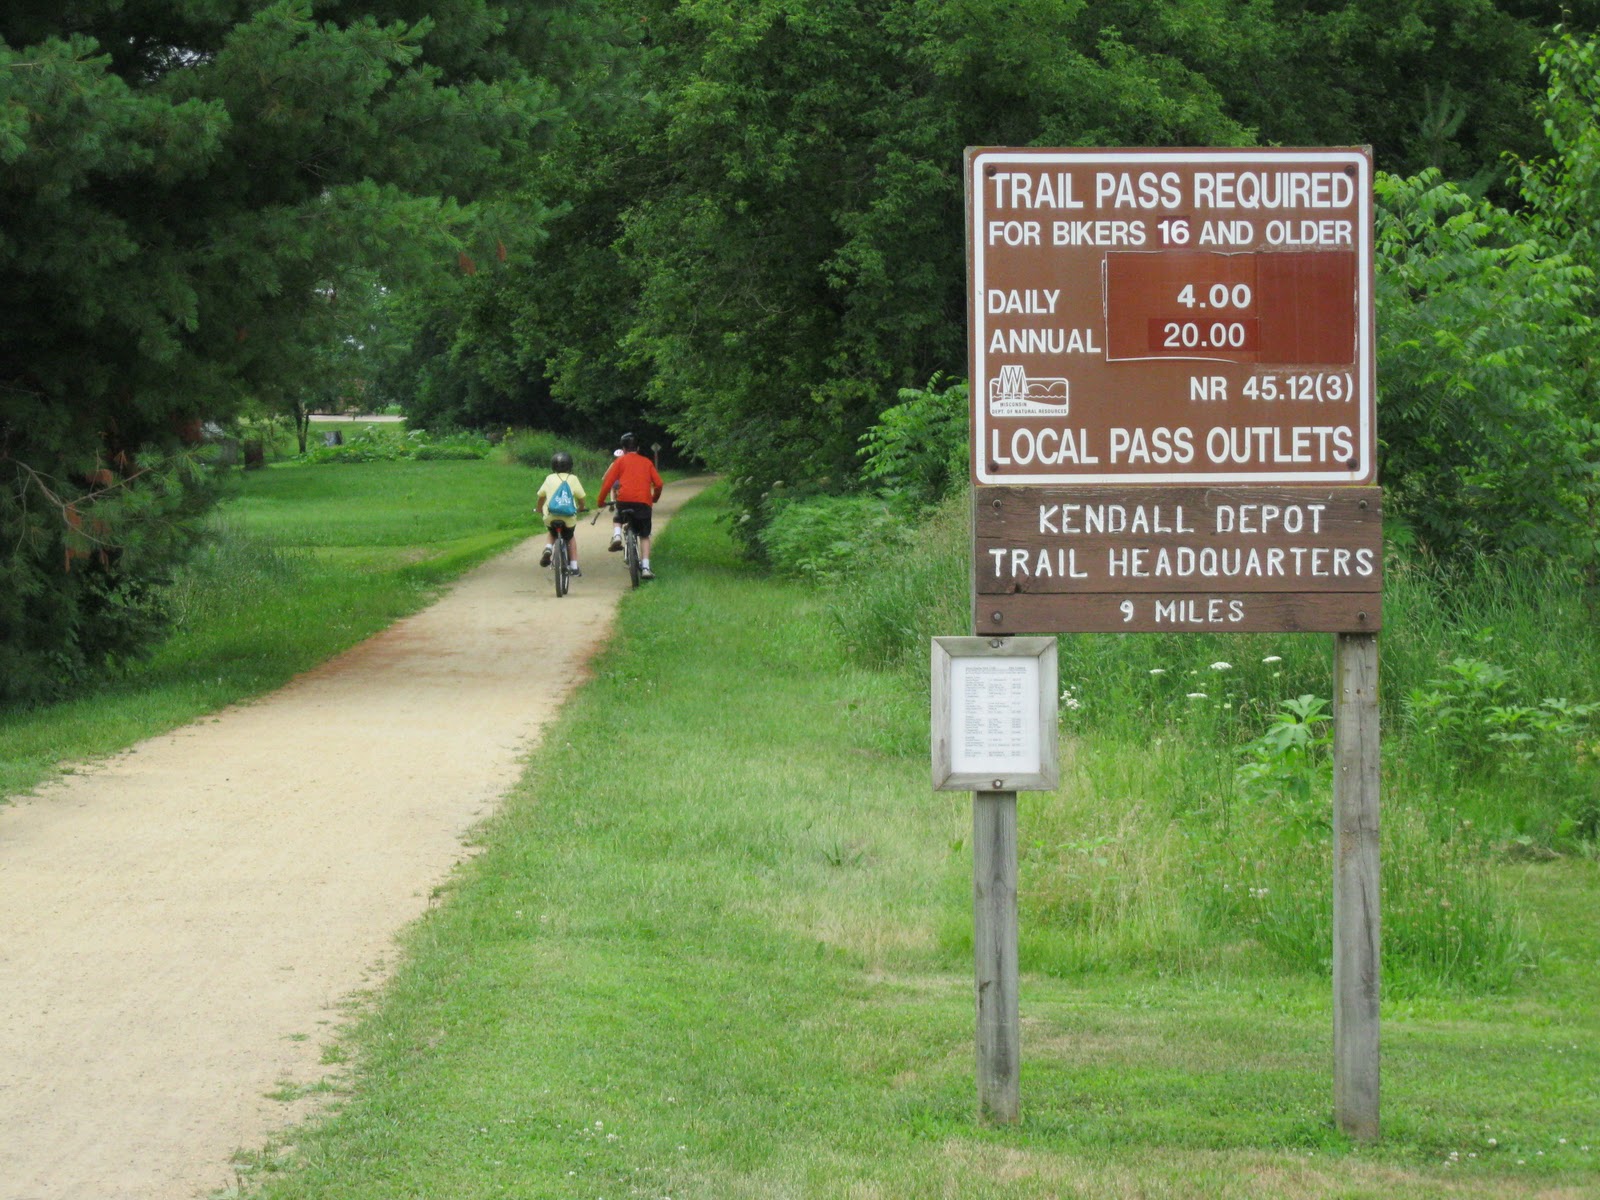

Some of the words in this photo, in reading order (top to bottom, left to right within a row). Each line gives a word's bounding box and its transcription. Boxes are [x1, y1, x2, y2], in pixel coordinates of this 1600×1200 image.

[989, 172, 1083, 210] TRAIL
[1096, 172, 1182, 208] PASS
[1193, 172, 1353, 208] REQUIRED
[989, 221, 1041, 246] FOR
[1053, 221, 1147, 246] BIKERS
[1158, 220, 1190, 243] 16
[1199, 221, 1253, 245] AND
[1265, 220, 1352, 245] OLDER
[988, 290, 1060, 314] DAILY
[1177, 285, 1251, 309] 4.00
[989, 329, 1101, 353] ANNUAL
[1163, 323, 1245, 347] 20.00
[1190, 376, 1227, 400] NR
[1242, 373, 1353, 401] 45.12(3)
[992, 428, 1099, 465] LOCAL
[1111, 427, 1194, 463] PASS
[1206, 426, 1353, 463] OUTLETS
[1039, 504, 1194, 535] KENDALL
[1216, 504, 1326, 535] DEPOT
[988, 548, 1088, 579] TRAIL
[1109, 547, 1374, 577] HEADQUARTERS
[1120, 601, 1134, 623] 9
[1155, 599, 1245, 623] MILES
